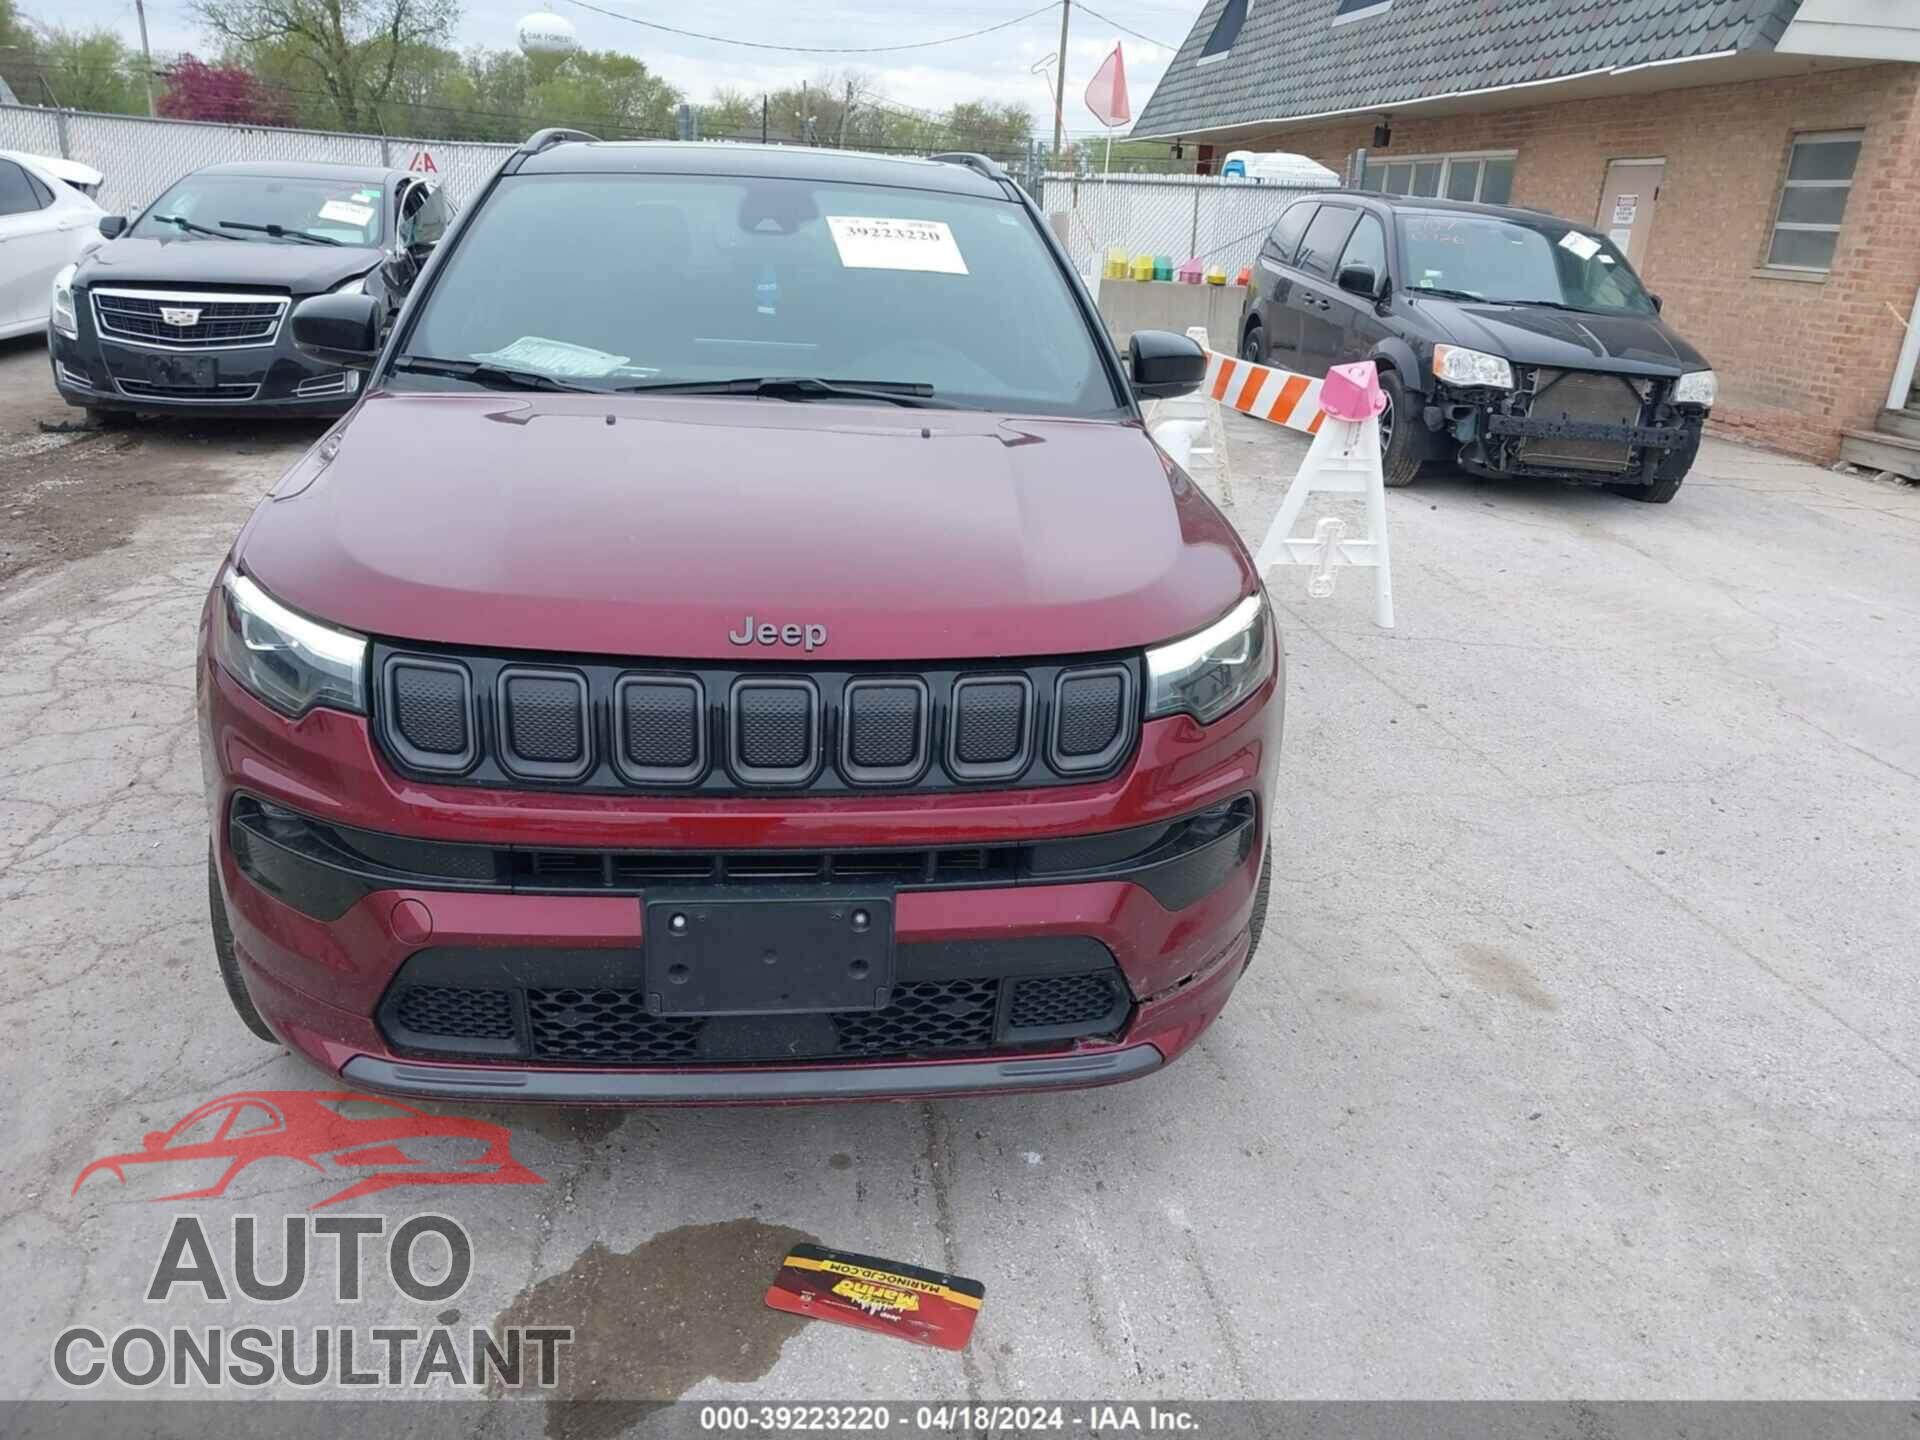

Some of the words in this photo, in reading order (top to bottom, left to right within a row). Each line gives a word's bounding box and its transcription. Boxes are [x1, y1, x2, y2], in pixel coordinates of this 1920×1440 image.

[846, 225, 941, 242] 39223220
[729, 616, 827, 652] Jeep
[830, 1263, 941, 1293] MARINOCJD.COM
